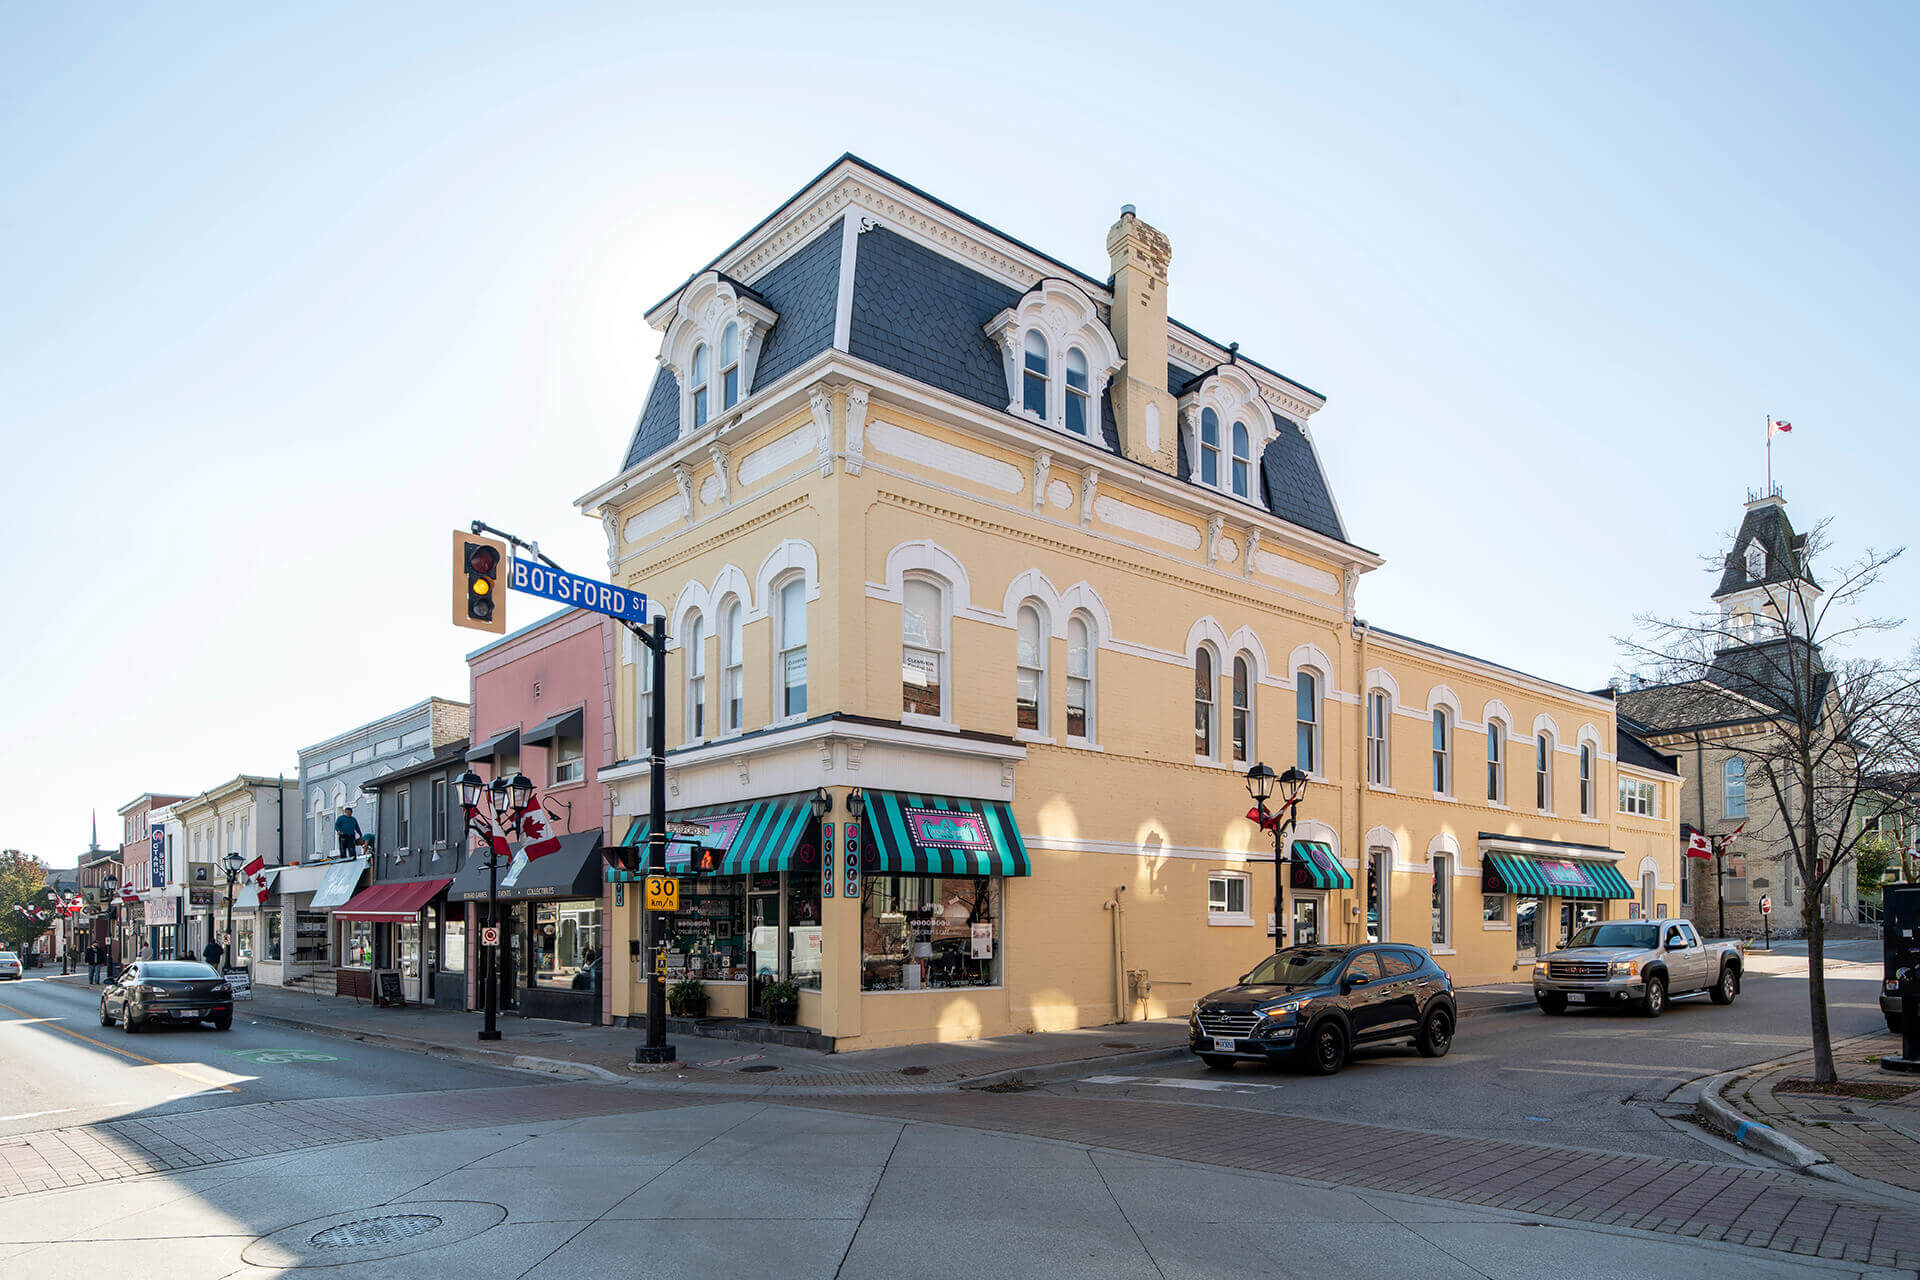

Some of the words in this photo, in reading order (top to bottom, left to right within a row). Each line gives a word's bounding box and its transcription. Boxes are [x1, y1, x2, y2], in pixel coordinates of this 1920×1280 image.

[515, 563, 625, 613] BOTSFORD
[632, 596, 646, 612] ST
[651, 880, 675, 896] 30
[651, 897, 674, 908] km/h
